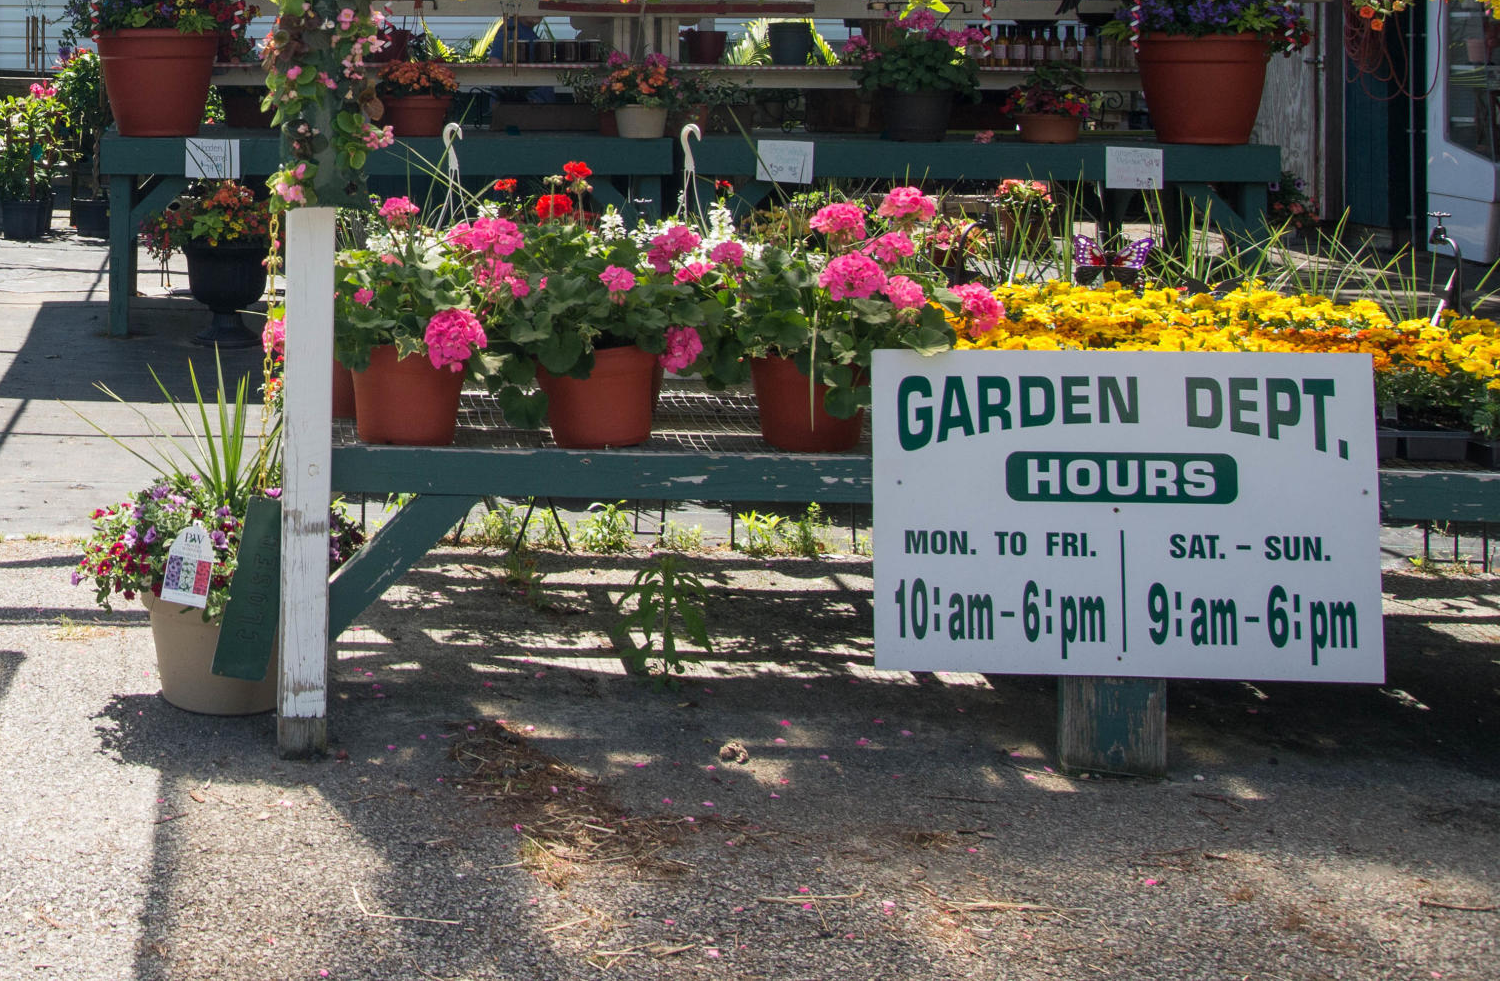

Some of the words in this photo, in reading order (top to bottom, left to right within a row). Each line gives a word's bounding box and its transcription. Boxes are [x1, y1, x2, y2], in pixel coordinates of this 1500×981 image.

[897, 375, 1140, 452] GARDEN
[1184, 376, 1349, 461] DEPT.
[1027, 458, 1217, 498] HOURS
[904, 530, 977, 556] MON.
[994, 530, 1028, 556] TO
[1046, 532, 1097, 558] FRI.
